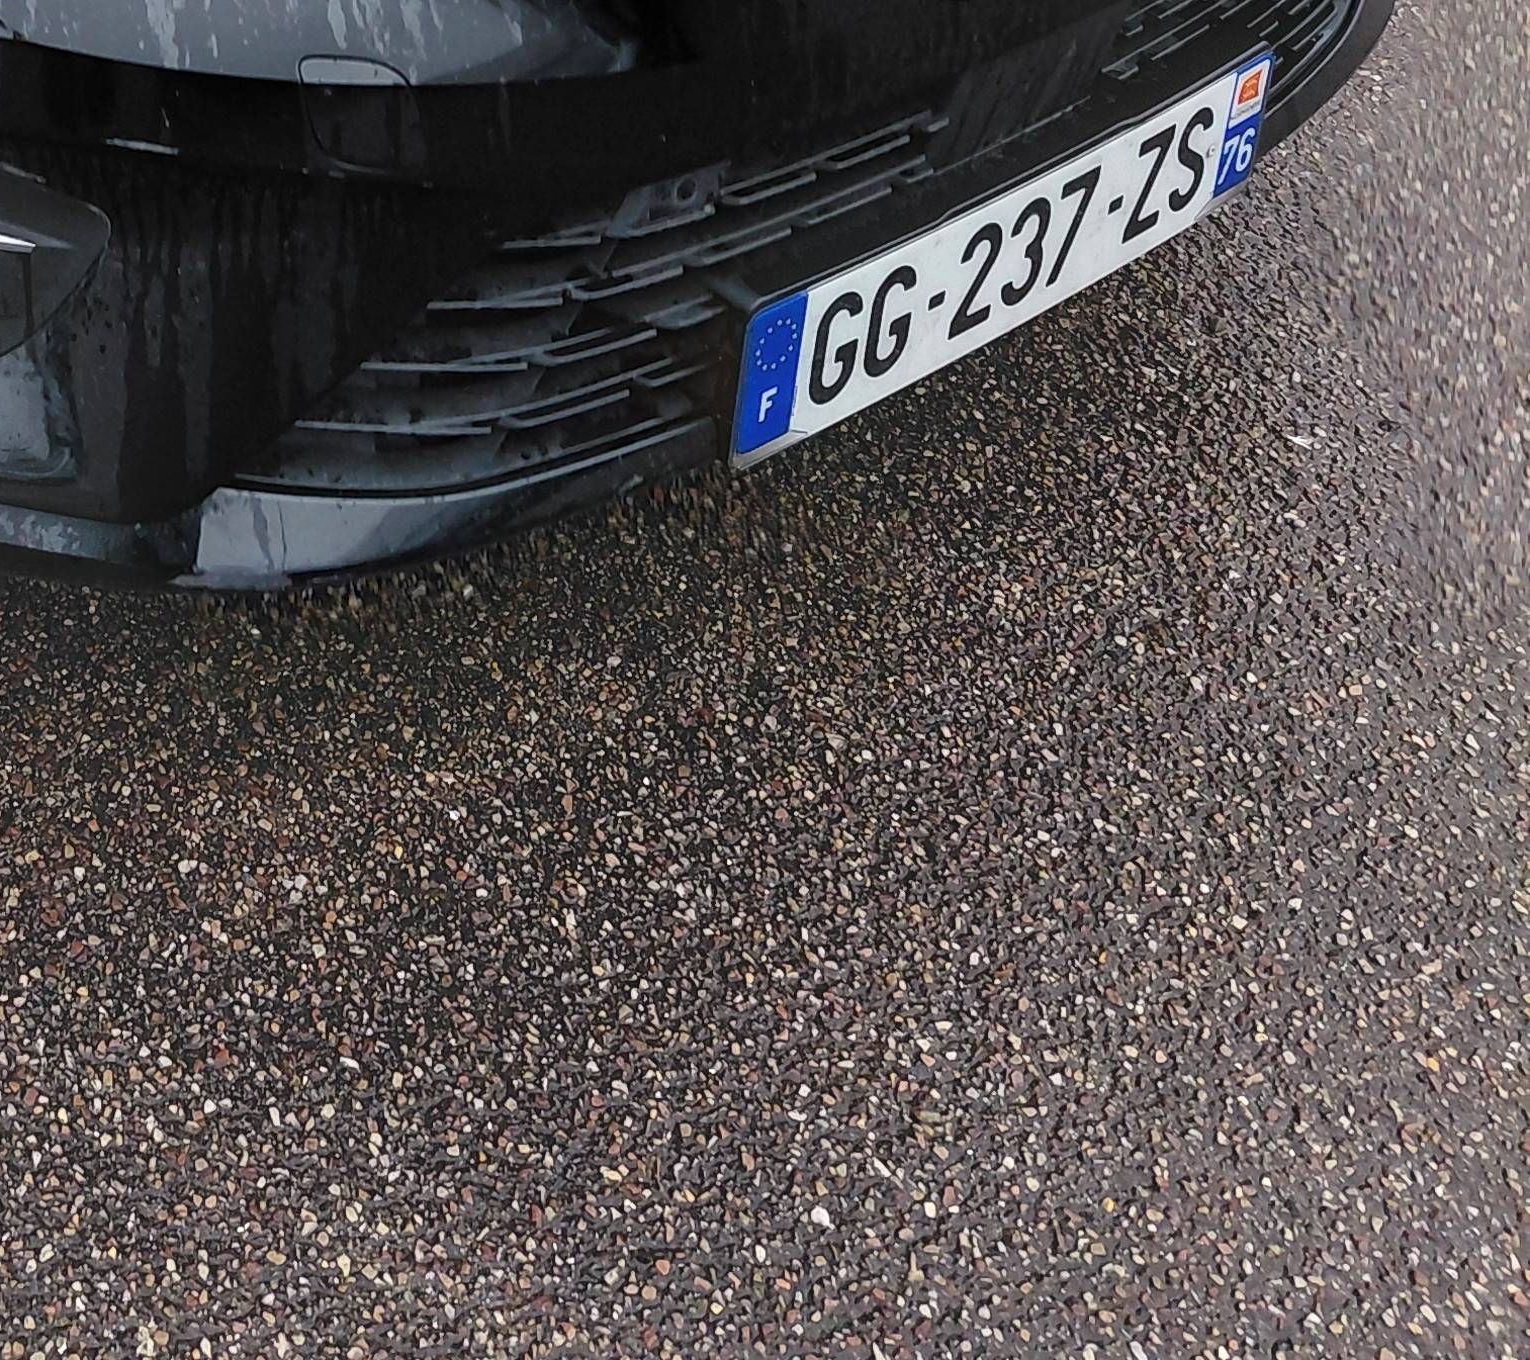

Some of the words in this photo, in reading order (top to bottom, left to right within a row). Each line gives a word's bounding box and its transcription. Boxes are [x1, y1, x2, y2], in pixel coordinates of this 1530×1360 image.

[1217, 127, 1256, 186] 76
[808, 107, 1214, 405] GG-237-ZS
[758, 385, 778, 422] F
